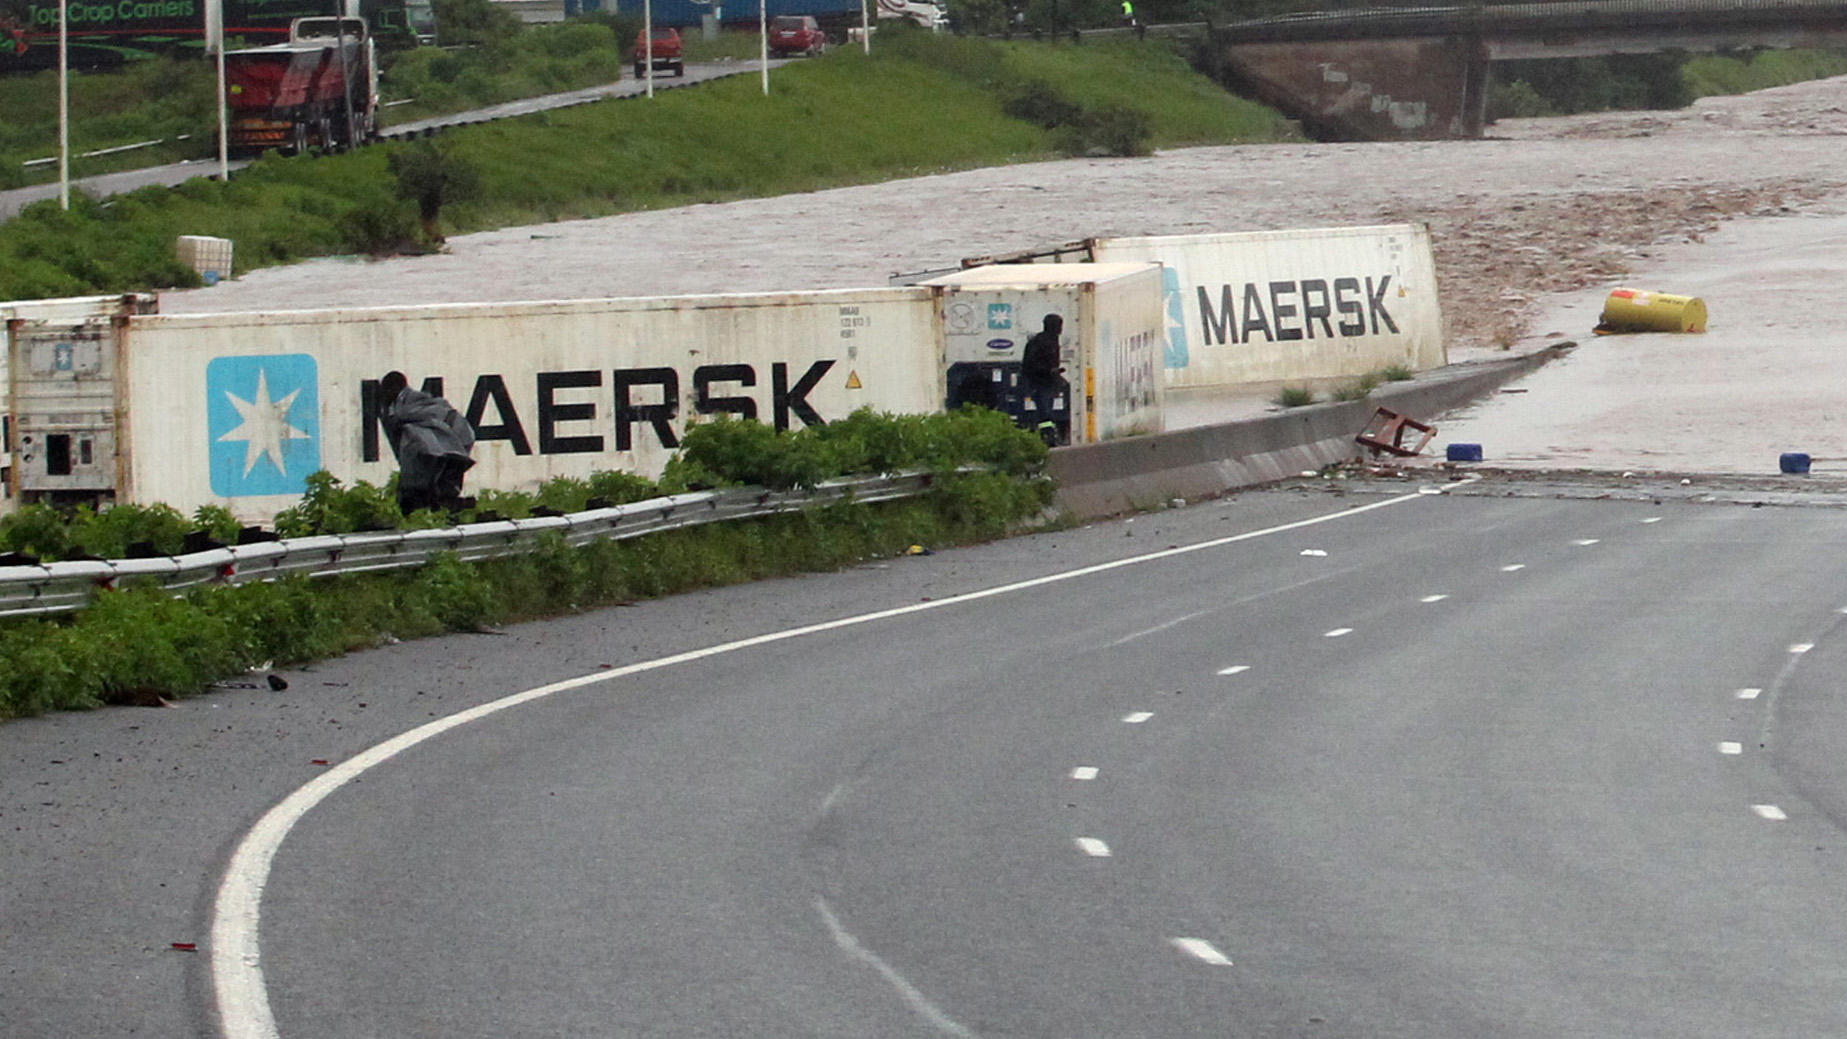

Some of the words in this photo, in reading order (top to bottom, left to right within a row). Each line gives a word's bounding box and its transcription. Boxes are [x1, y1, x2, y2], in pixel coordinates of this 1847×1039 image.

[29, 4, 61, 25] Top
[67, 2, 114, 24] Crop
[1198, 276, 1399, 345] MAERSK
